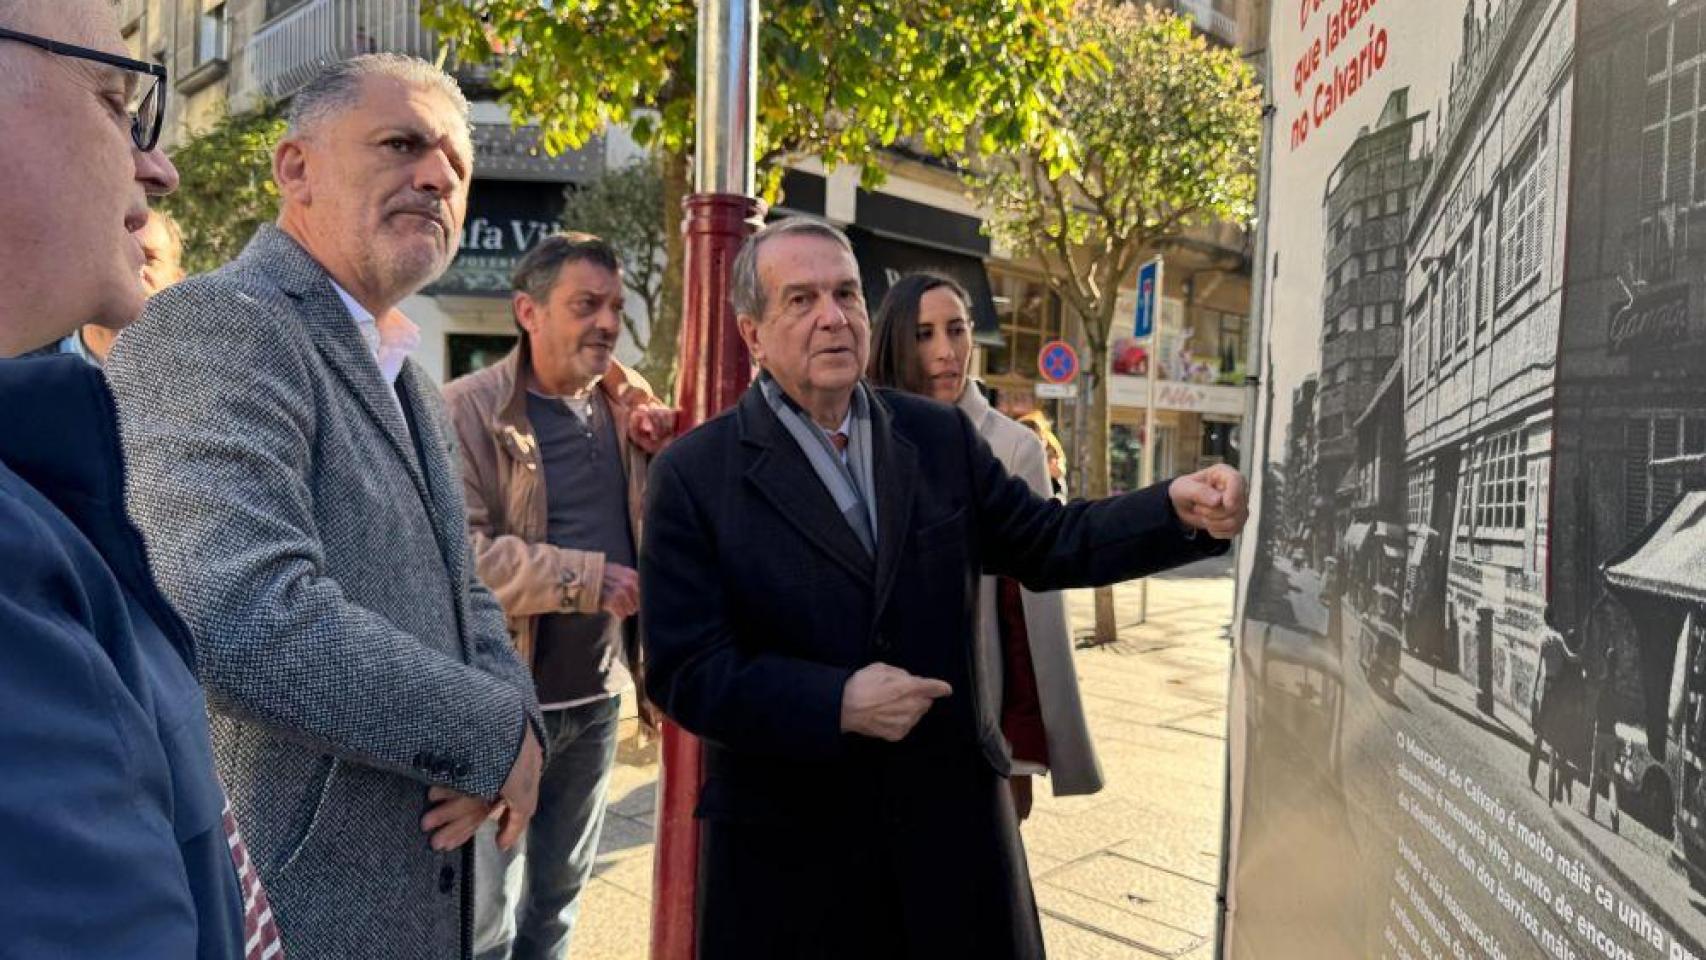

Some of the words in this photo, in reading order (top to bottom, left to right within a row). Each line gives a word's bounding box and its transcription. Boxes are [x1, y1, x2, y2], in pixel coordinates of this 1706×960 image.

[1291, 109, 1309, 152] no
[1314, 23, 1388, 128] Calvario
[1294, 37, 1321, 98] que
[1325, 0, 1377, 58] latex
[1396, 731, 1405, 749] O
[1405, 735, 1448, 778] Mercado
[1449, 766, 1462, 789] do
[1464, 775, 1506, 824] Calvario
[1507, 810, 1516, 833] é
[1517, 821, 1554, 864] moito
[1557, 854, 1591, 895] máis
[1595, 884, 1613, 913] ca
[1618, 900, 1663, 953] unha
[1444, 797, 1487, 846] memoria
[1488, 834, 1511, 874] viva,
[1514, 858, 1552, 904] punto
[1555, 893, 1574, 924] de
[1458, 844, 1477, 875] dun
[1477, 863, 1495, 896] dos
[1497, 880, 1540, 937] barrios
